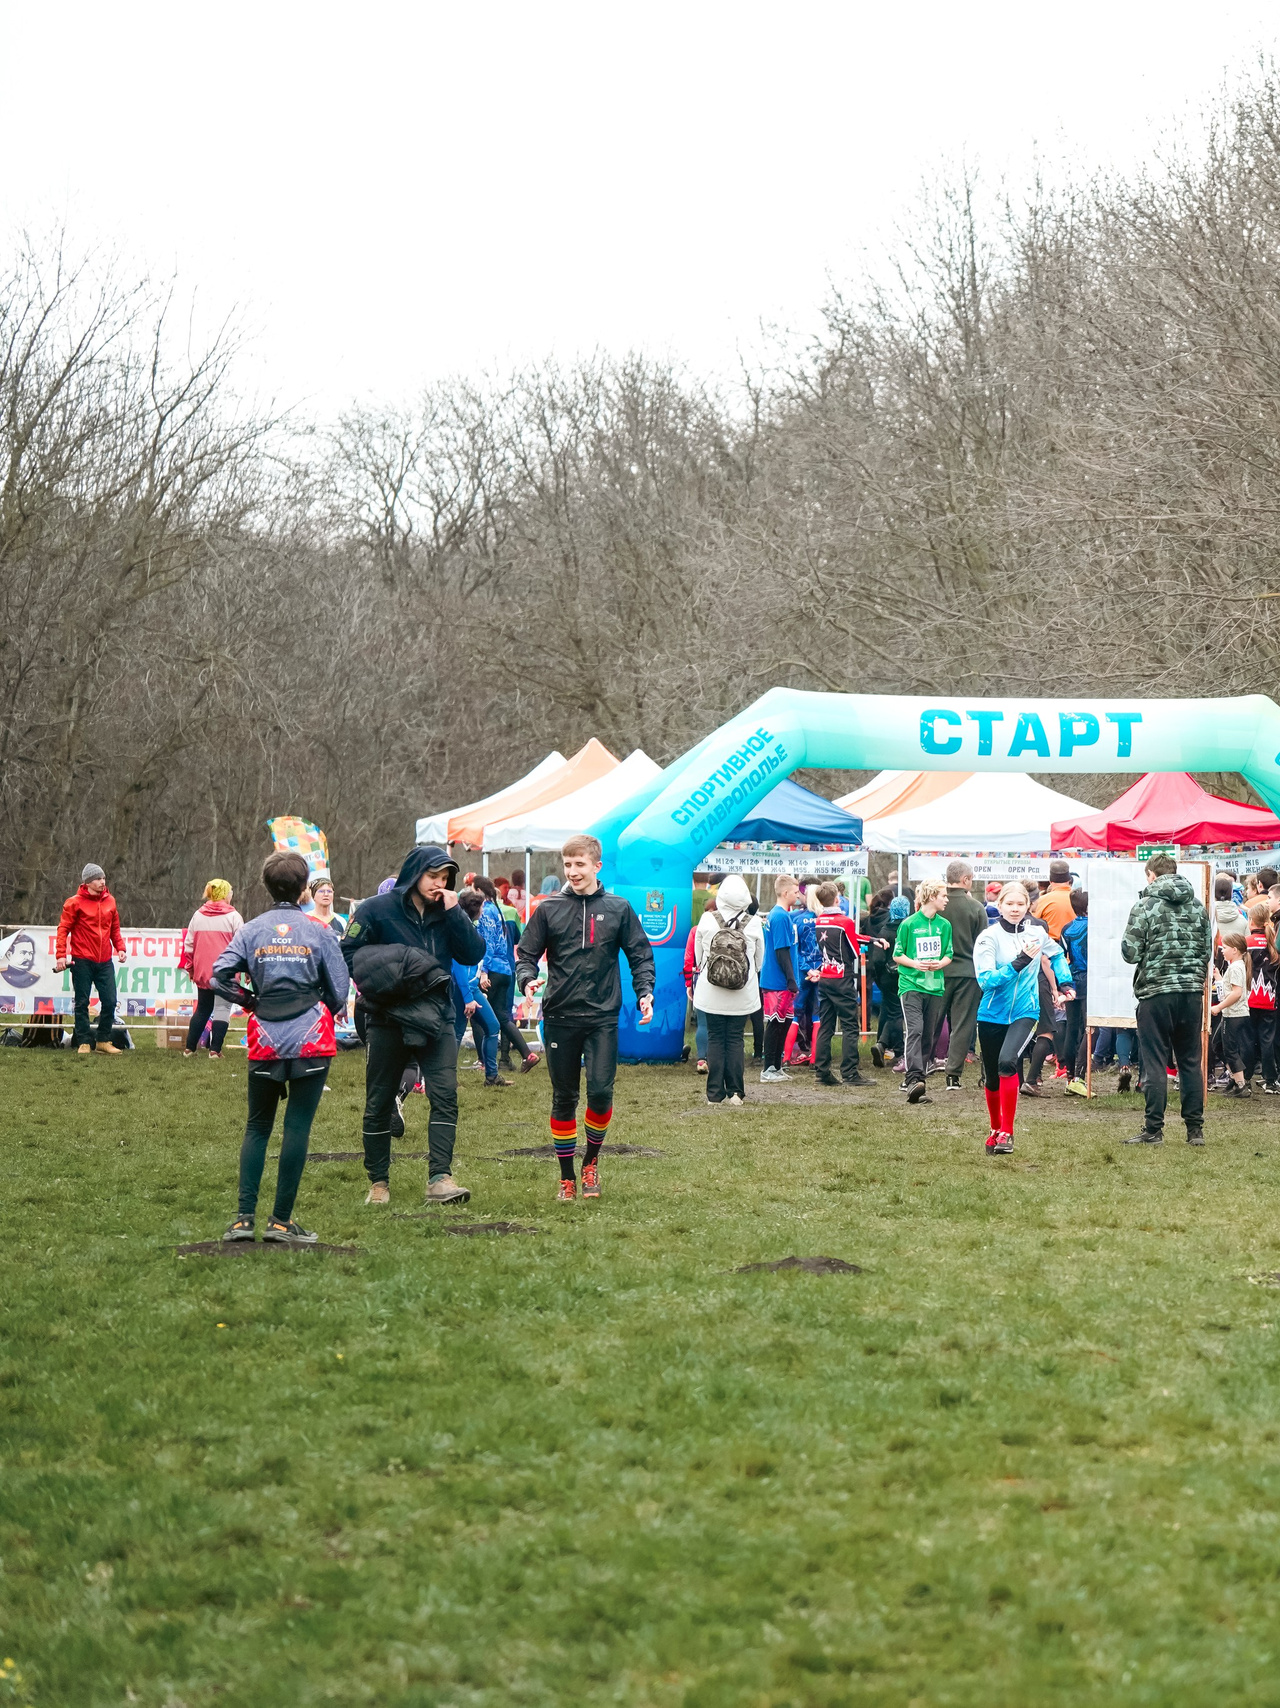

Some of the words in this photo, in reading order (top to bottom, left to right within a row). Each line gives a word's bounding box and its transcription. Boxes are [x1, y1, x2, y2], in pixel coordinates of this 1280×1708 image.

[920, 709, 1143, 757] СТАРТ
[670, 727, 775, 826] СПОРТИВНОЕ
[689, 743, 788, 846] СТАВРОПОЛЬЕ
[254, 945, 312, 957] НАВИГАТОР
[917, 941, 938, 952] 1818
